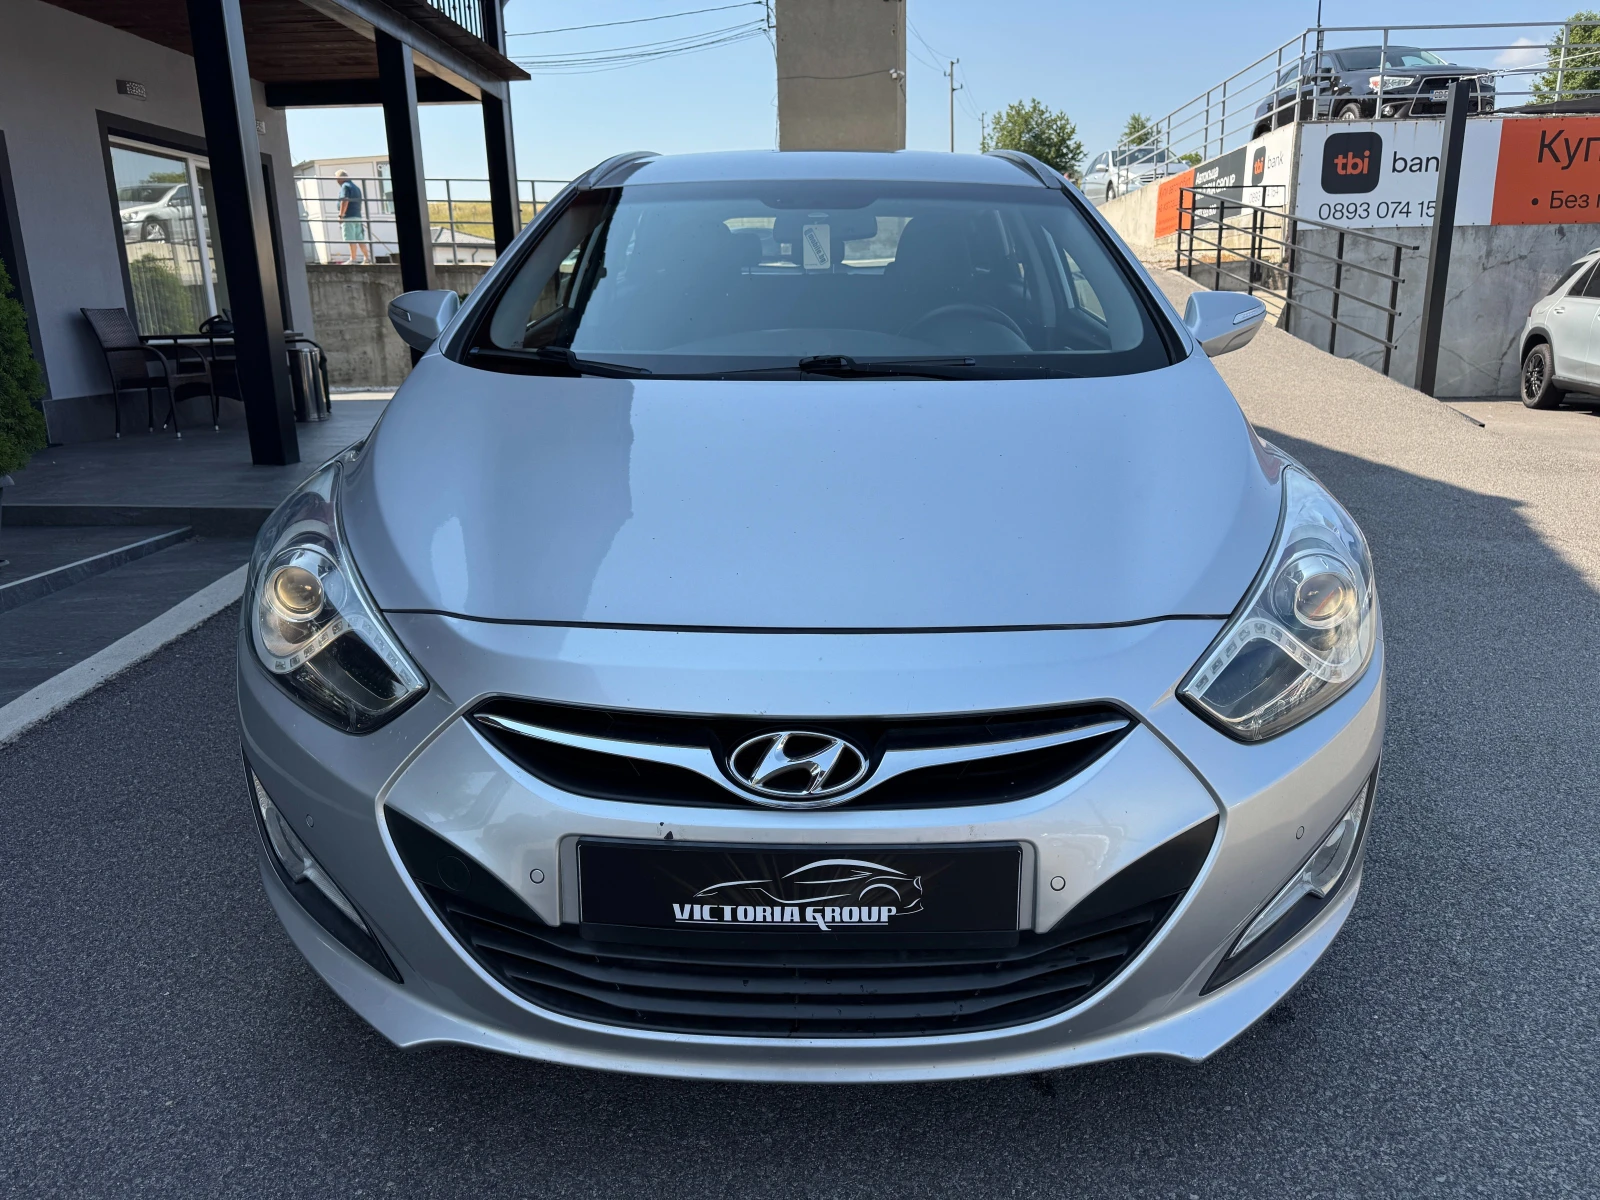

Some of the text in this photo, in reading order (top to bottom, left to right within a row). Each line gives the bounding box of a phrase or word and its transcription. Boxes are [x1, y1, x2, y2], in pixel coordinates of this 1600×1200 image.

[1333, 150, 1440, 175] tbi ban
[1538, 130, 1600, 170] Куп
[1253, 151, 1284, 175] tbi bank
[1318, 200, 1437, 220] 0893 074 15
[1550, 190, 1590, 209] Без
[807, 233, 827, 264] mobile.bg
[672, 903, 897, 931] VICTORIA GROUP
